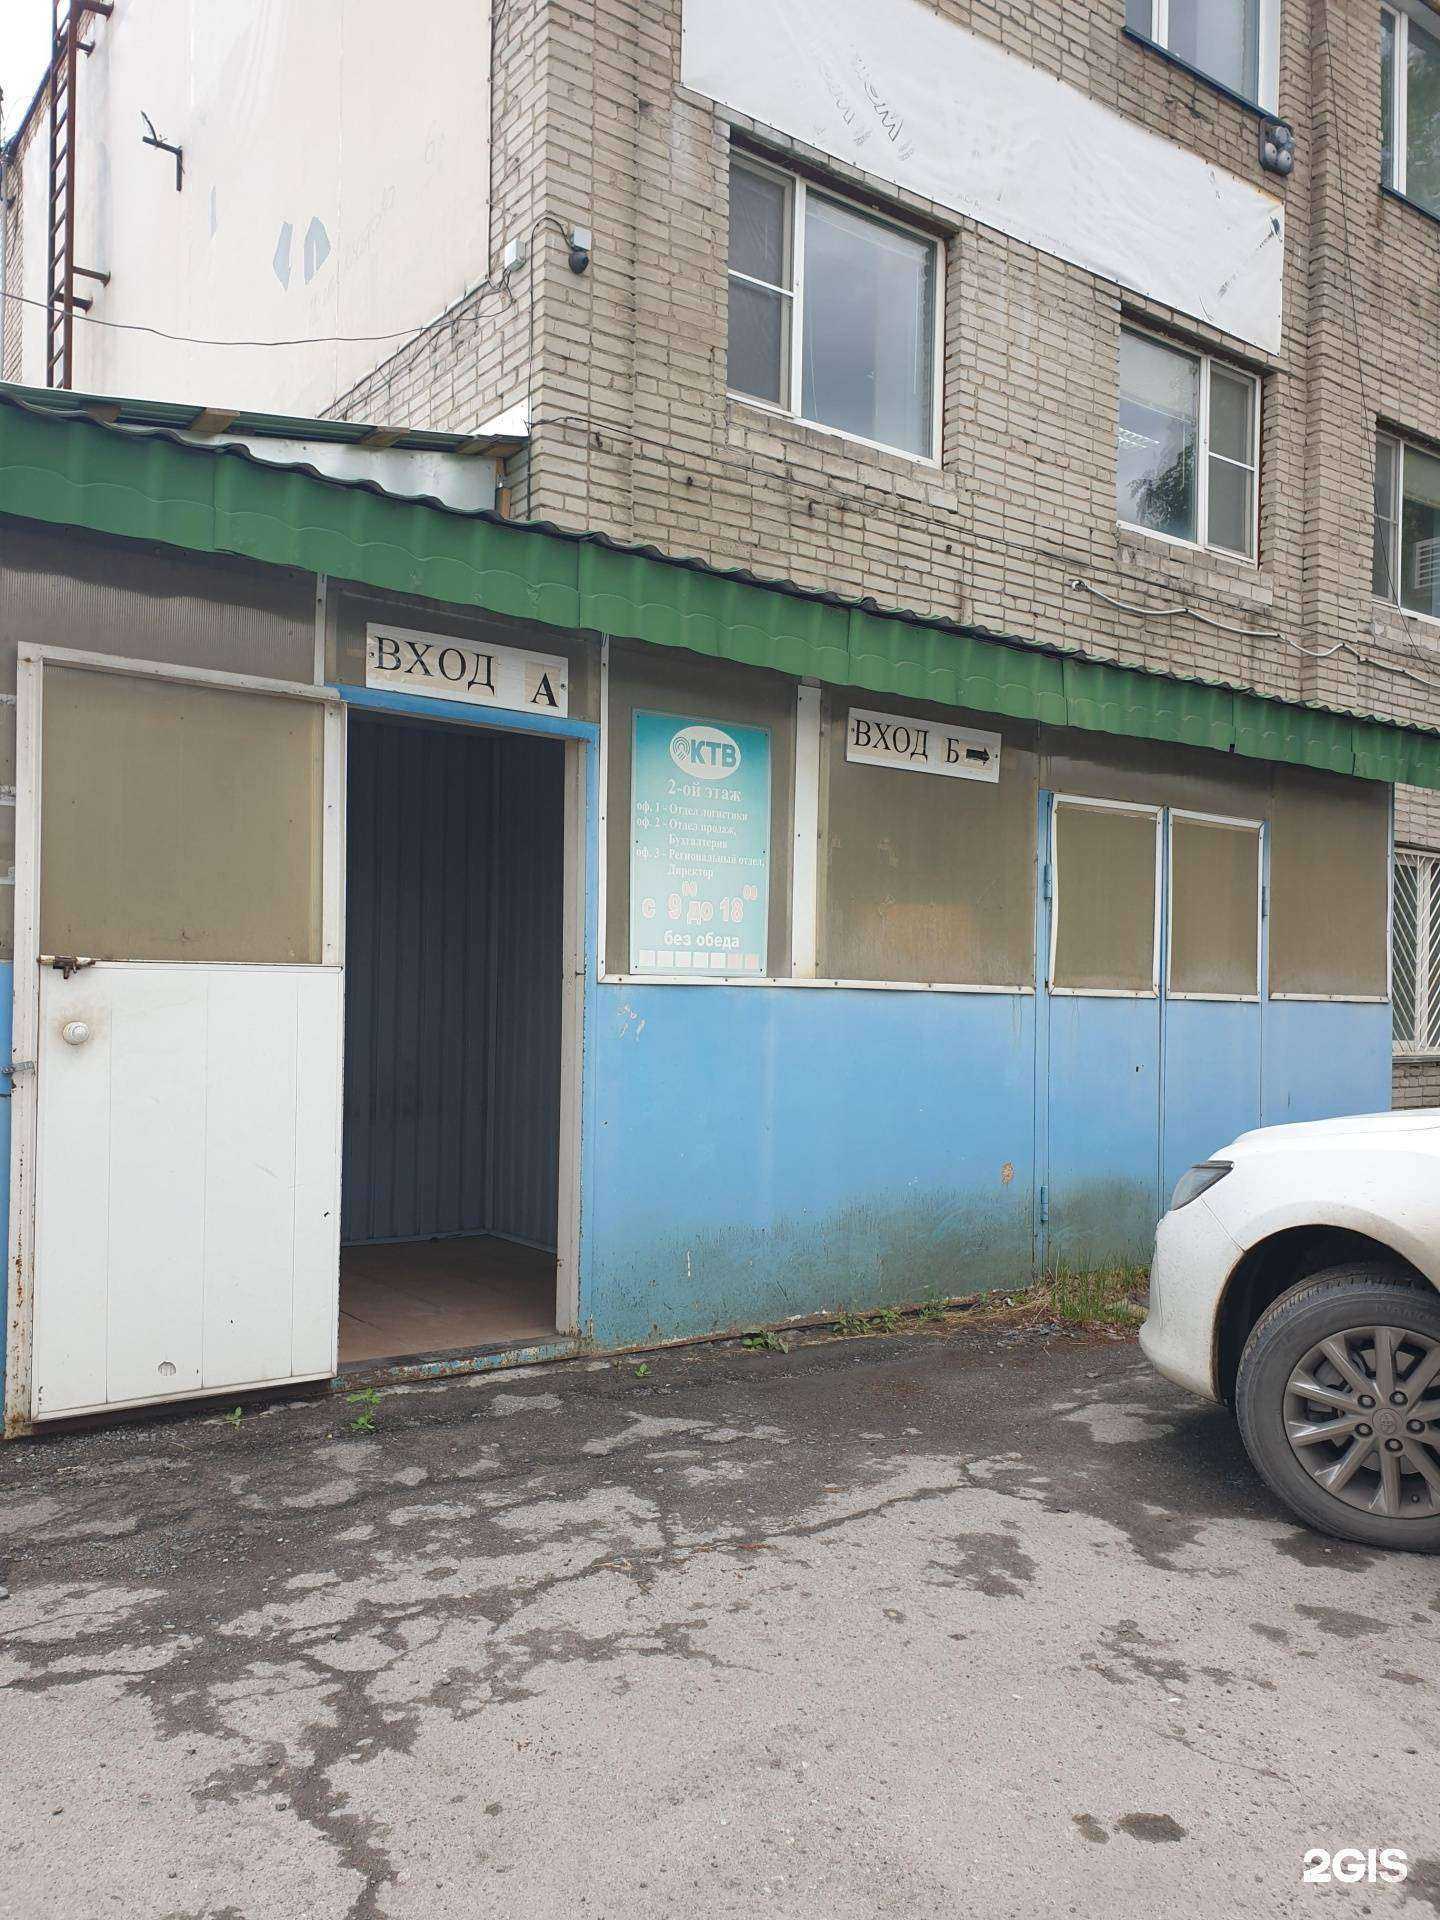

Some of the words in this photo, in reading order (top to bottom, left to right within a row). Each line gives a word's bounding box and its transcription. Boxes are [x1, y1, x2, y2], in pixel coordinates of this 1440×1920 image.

[374, 635, 495, 696] ВХОД
[530, 672, 558, 708] А
[853, 719, 929, 763] ВХОД
[944, 737, 960, 764] Б
[690, 739, 737, 768] КТВ
[666, 779, 701, 797] 2-ой
[704, 786, 742, 802] этаж
[655, 802, 661, 812] 1
[669, 803, 699, 816] Отдел
[655, 817, 661, 828] 2
[654, 848, 661, 859] 3
[667, 893, 681, 920] 9
[687, 900, 714, 925] до
[720, 897, 744, 923] 18
[664, 930, 692, 946] без
[696, 932, 740, 950] обеда
